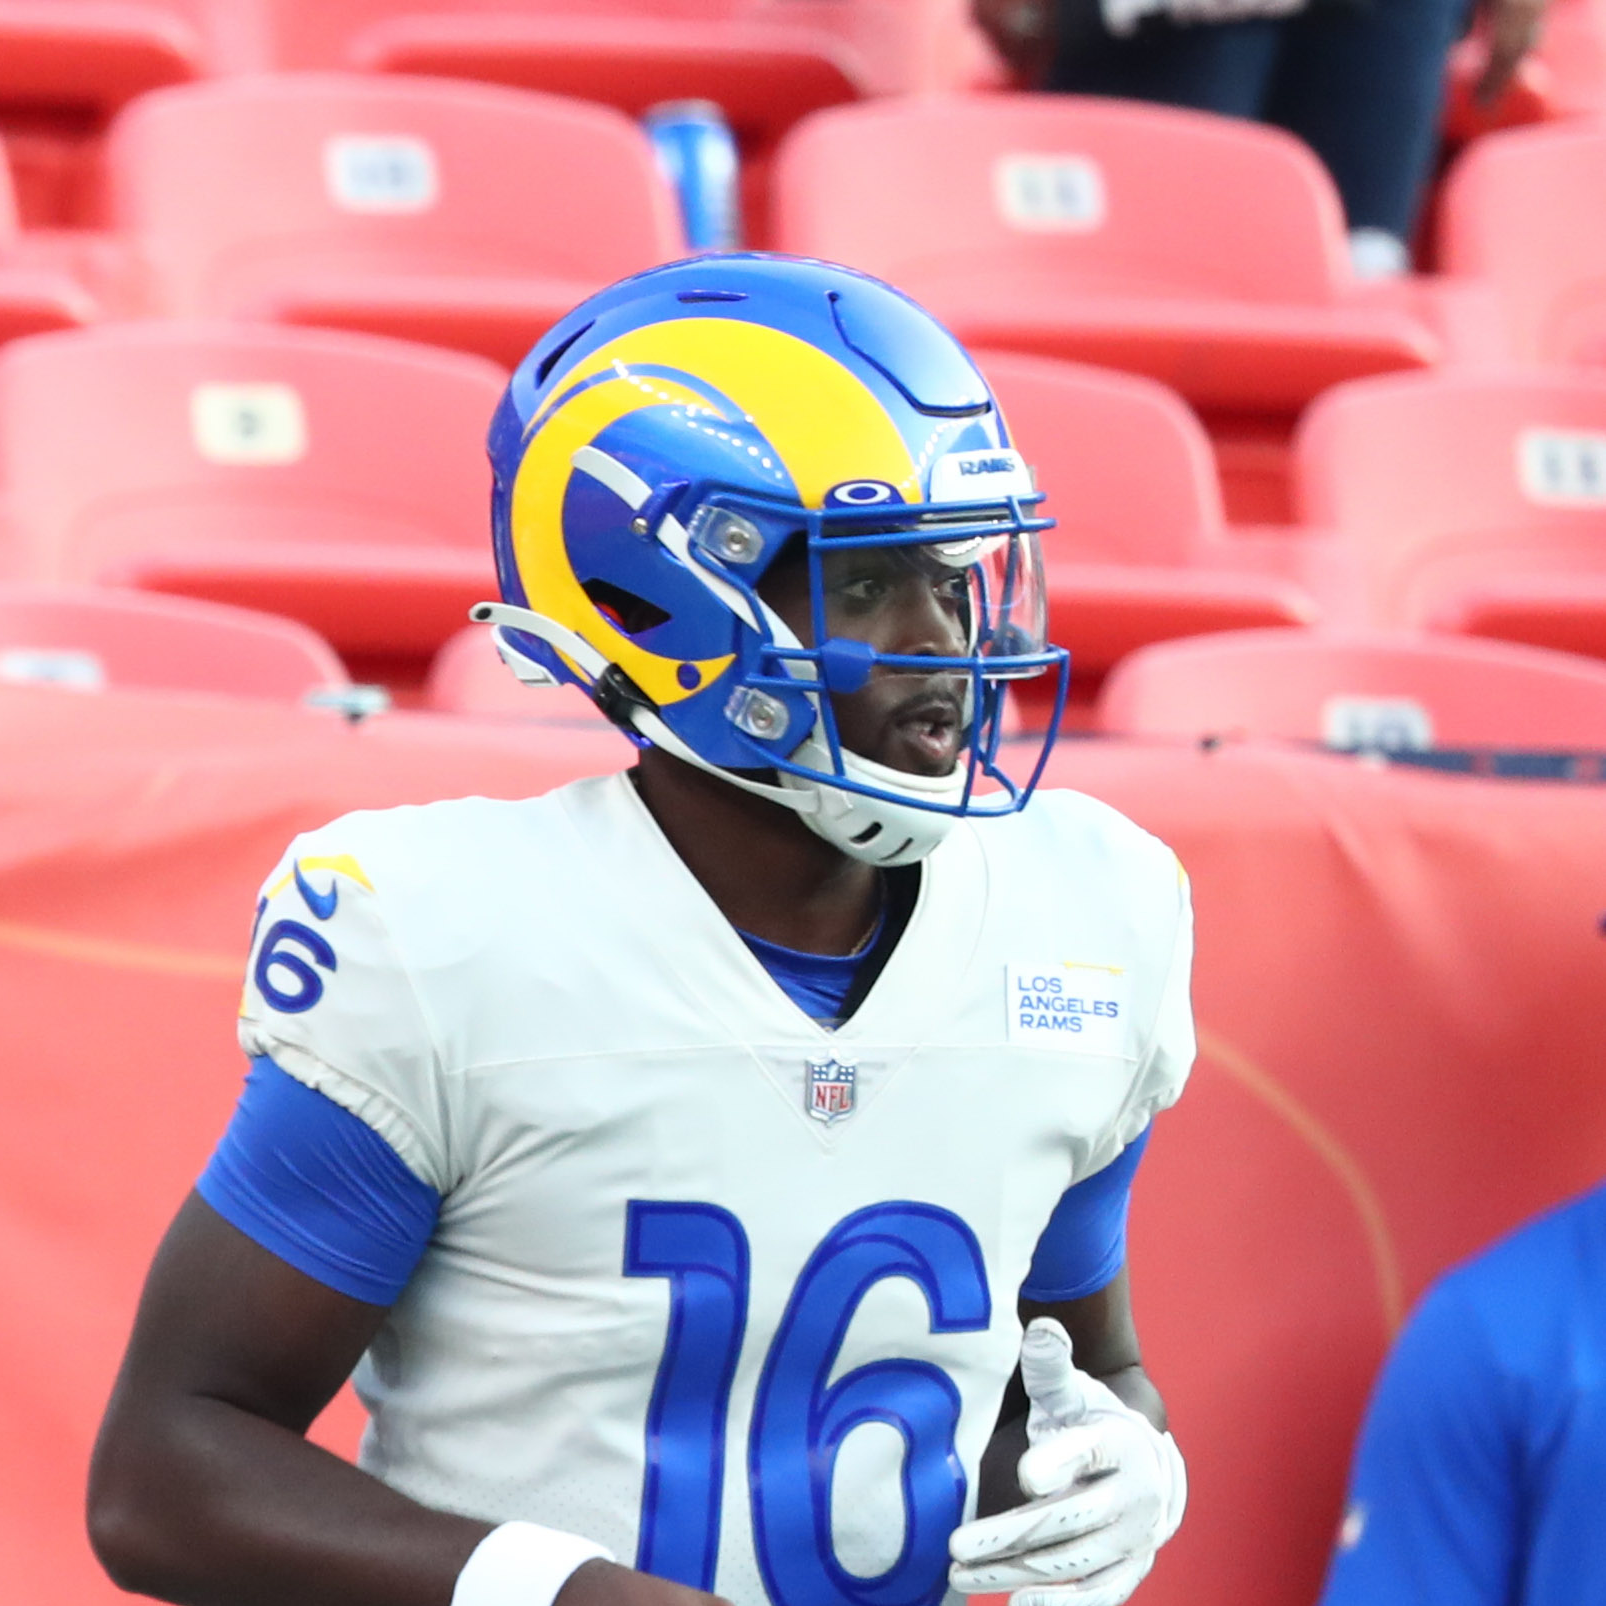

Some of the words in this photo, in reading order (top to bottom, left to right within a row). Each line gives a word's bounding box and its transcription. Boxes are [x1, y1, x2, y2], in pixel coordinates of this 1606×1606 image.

[959, 457, 1016, 476] RAMS
[1017, 975, 1063, 994] LOS
[1018, 994, 1119, 1019] ANGELES
[1019, 1012, 1083, 1033] RAMS
[815, 1084, 851, 1113] NFL
